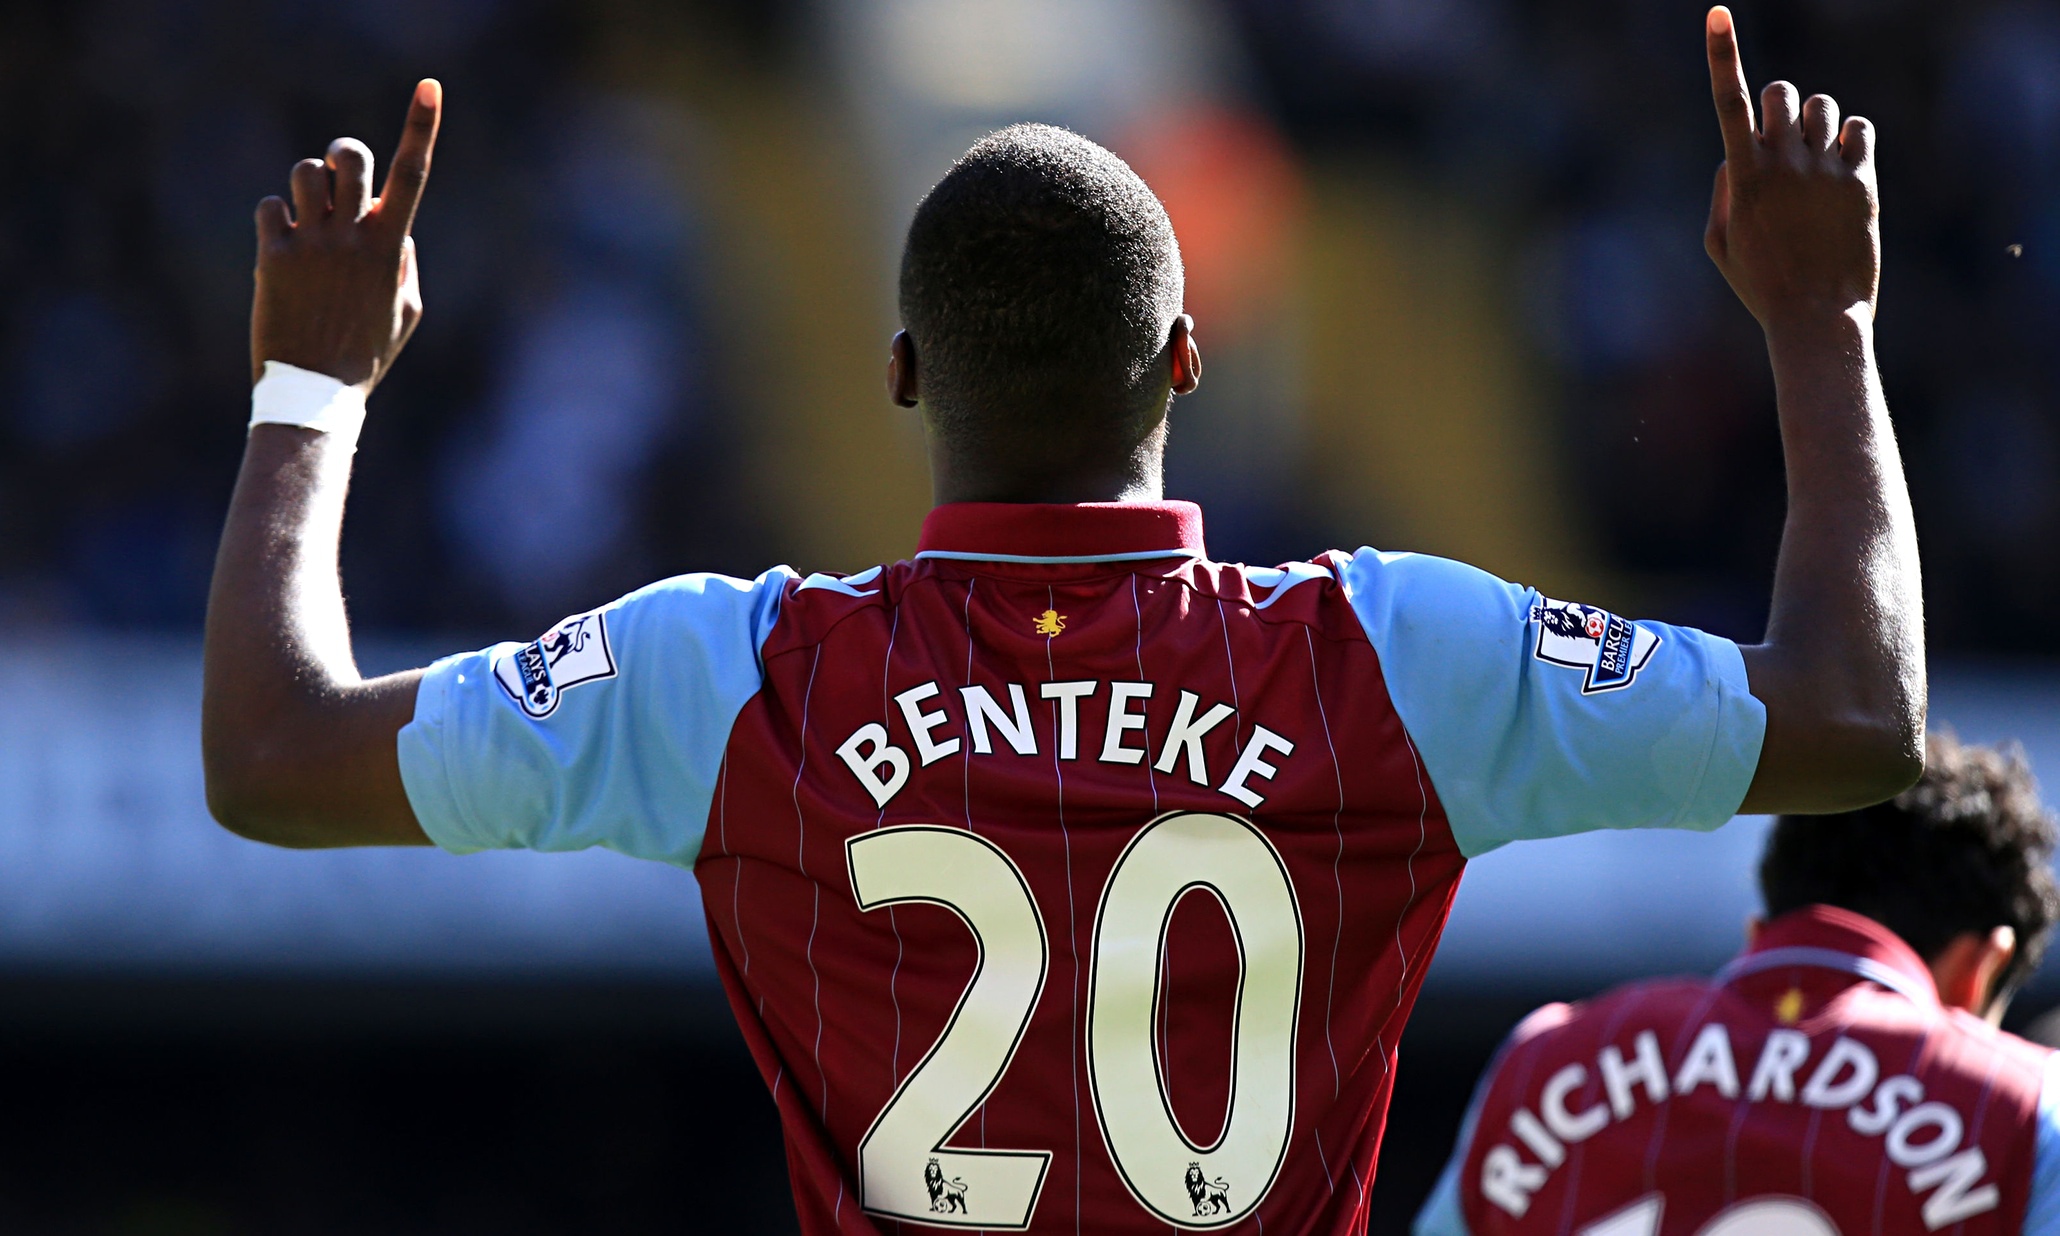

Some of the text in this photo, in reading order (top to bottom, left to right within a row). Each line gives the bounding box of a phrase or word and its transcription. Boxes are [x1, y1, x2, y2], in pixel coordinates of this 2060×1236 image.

[525, 644, 547, 681] LAYS
[1615, 637, 1630, 675] PREMIER
[836, 680, 1294, 809] BENTEKE
[845, 810, 1305, 1231] 20
[1481, 1023, 2000, 1231] RICHARDSON
